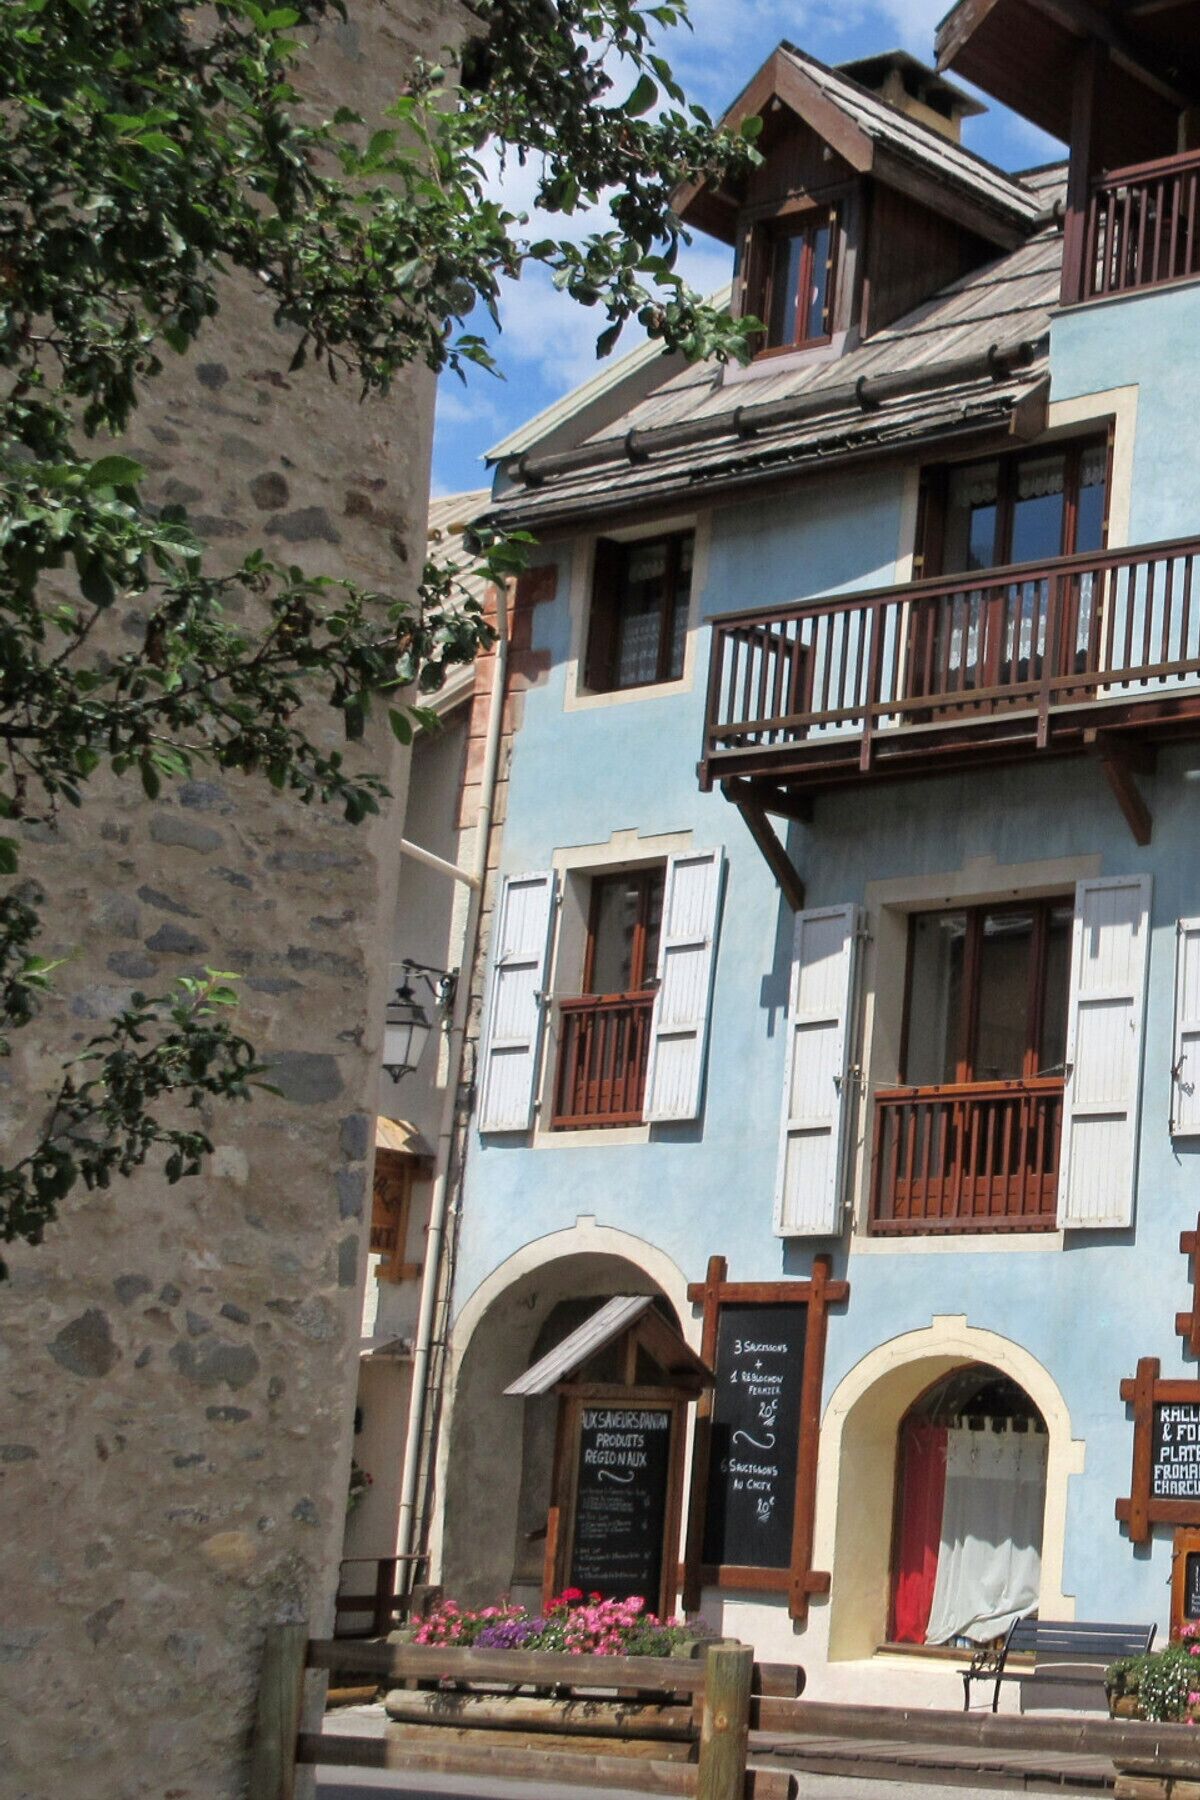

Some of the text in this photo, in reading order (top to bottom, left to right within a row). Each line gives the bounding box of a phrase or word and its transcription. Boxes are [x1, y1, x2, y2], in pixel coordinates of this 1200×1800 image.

[734, 1339, 742, 1354] 3
[730, 1370, 737, 1383] 1
[1162, 1423, 1173, 1441] &
[596, 1433, 645, 1448] PRODUITS
